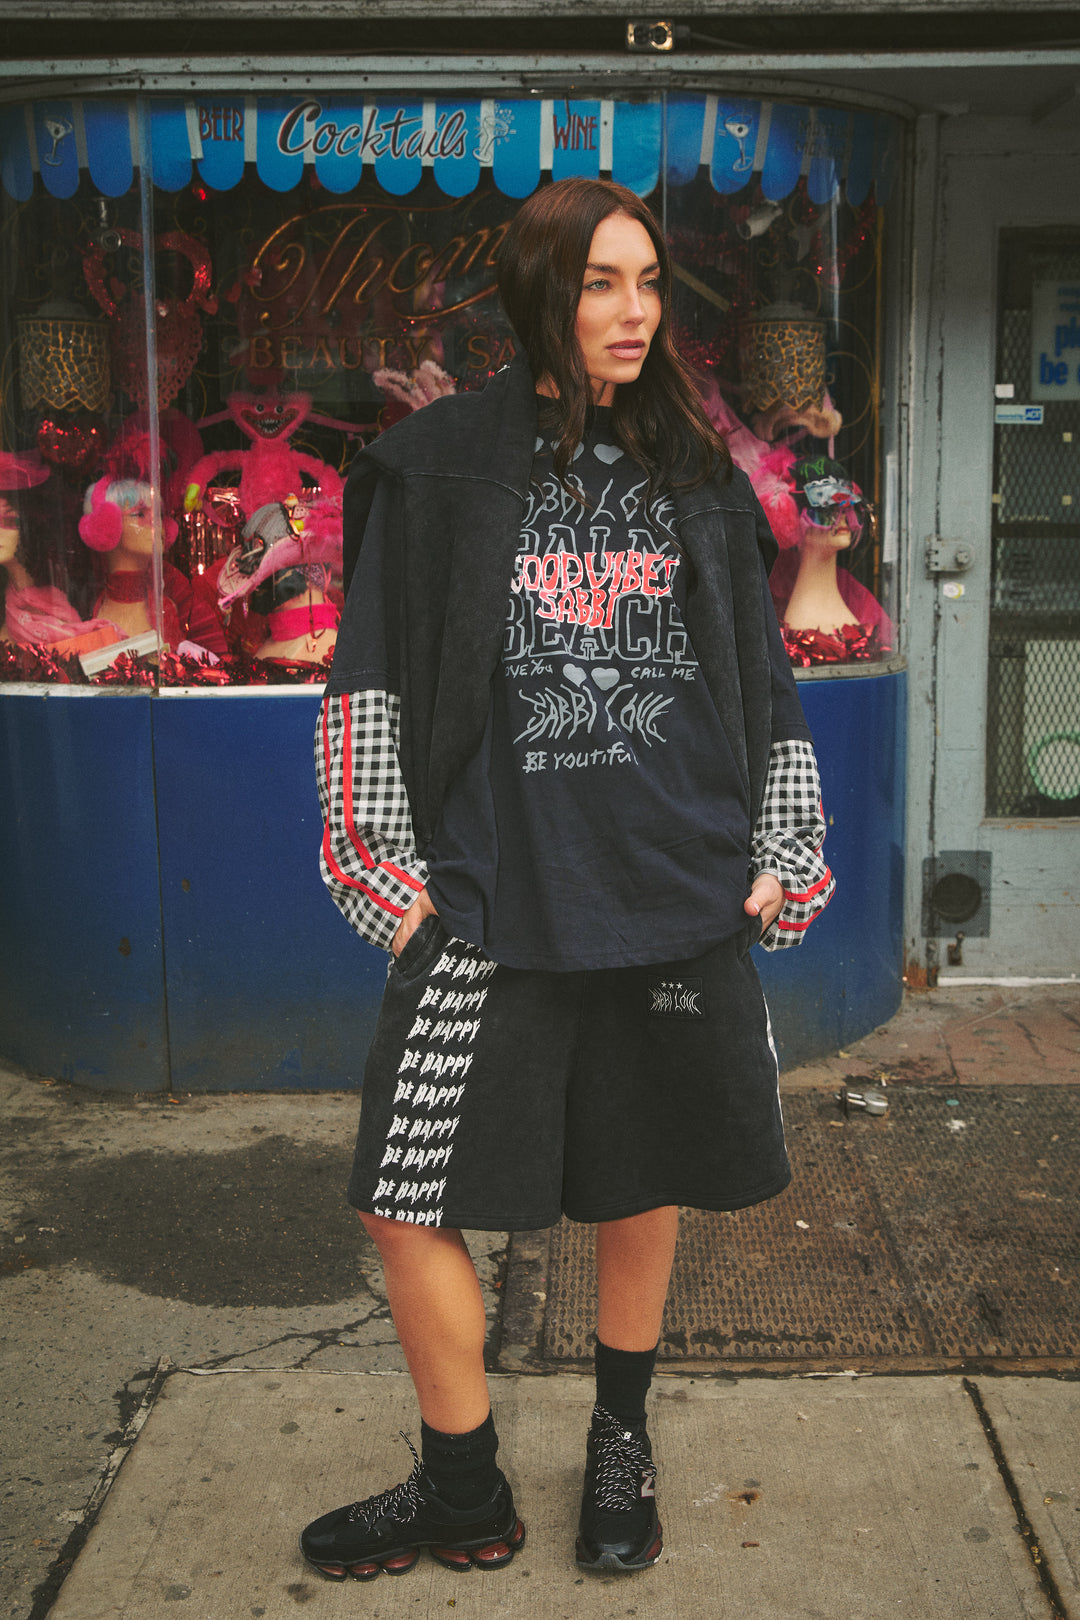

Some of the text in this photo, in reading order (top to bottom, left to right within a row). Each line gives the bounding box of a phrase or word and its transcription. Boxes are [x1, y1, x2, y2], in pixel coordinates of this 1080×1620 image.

[200, 107, 244, 142] BEER
[276, 101, 468, 160] Cocktails
[553, 112, 598, 150] WINE
[249, 336, 434, 369] BEAUTY
[1040, 353, 1068, 386] be
[535, 587, 621, 629] SABBI
[630, 666, 697, 681] CALL ME
[513, 683, 676, 748] SABBI LOVE
[522, 751, 548, 774] BE
[429, 951, 499, 984] BE HAPPY
[416, 985, 489, 1016] BE HAPPY
[405, 1014, 481, 1045] BE HAPPY
[396, 1048, 474, 1080] BE HAPPY
[392, 1078, 467, 1111] BE HAPPY
[385, 1113, 461, 1144] BE HAPPY
[379, 1143, 454, 1174] BE HAPPY
[371, 1176, 447, 1206] BE HAPPY
